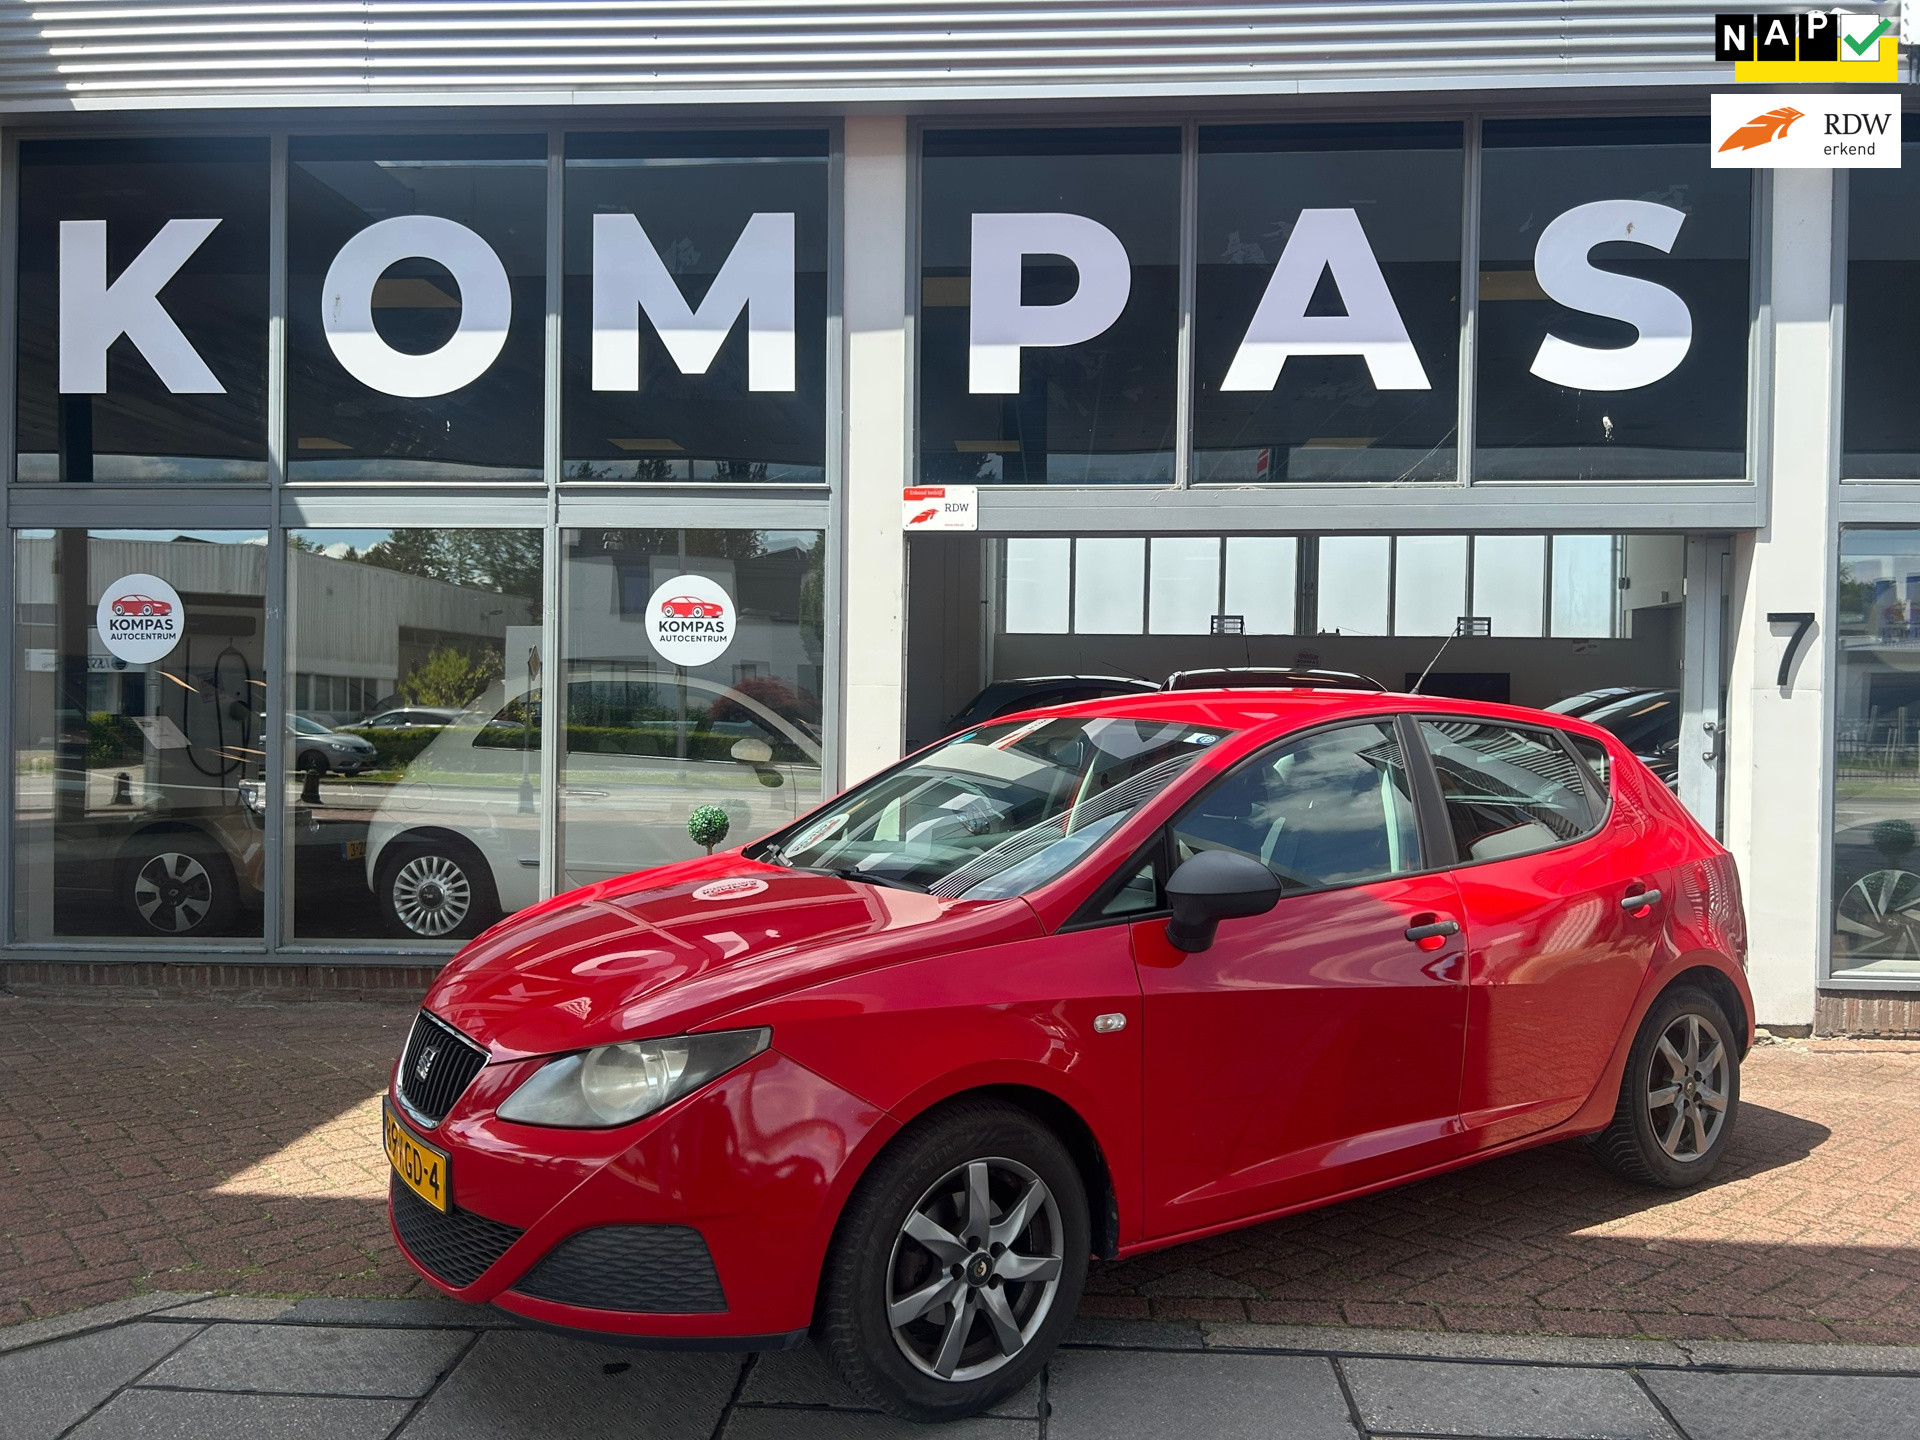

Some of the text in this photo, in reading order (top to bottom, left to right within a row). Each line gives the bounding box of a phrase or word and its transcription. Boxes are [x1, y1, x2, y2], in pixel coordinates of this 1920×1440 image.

[60, 199, 1693, 398] KOMPAS
[944, 503, 969, 512] RDW
[109, 619, 173, 631] KOMPAS
[658, 620, 725, 633] KOMPAS
[110, 632, 177, 641] AUTOCENTRUM
[659, 634, 728, 643] AUTOCENTRUM
[1766, 612, 1816, 686] 7
